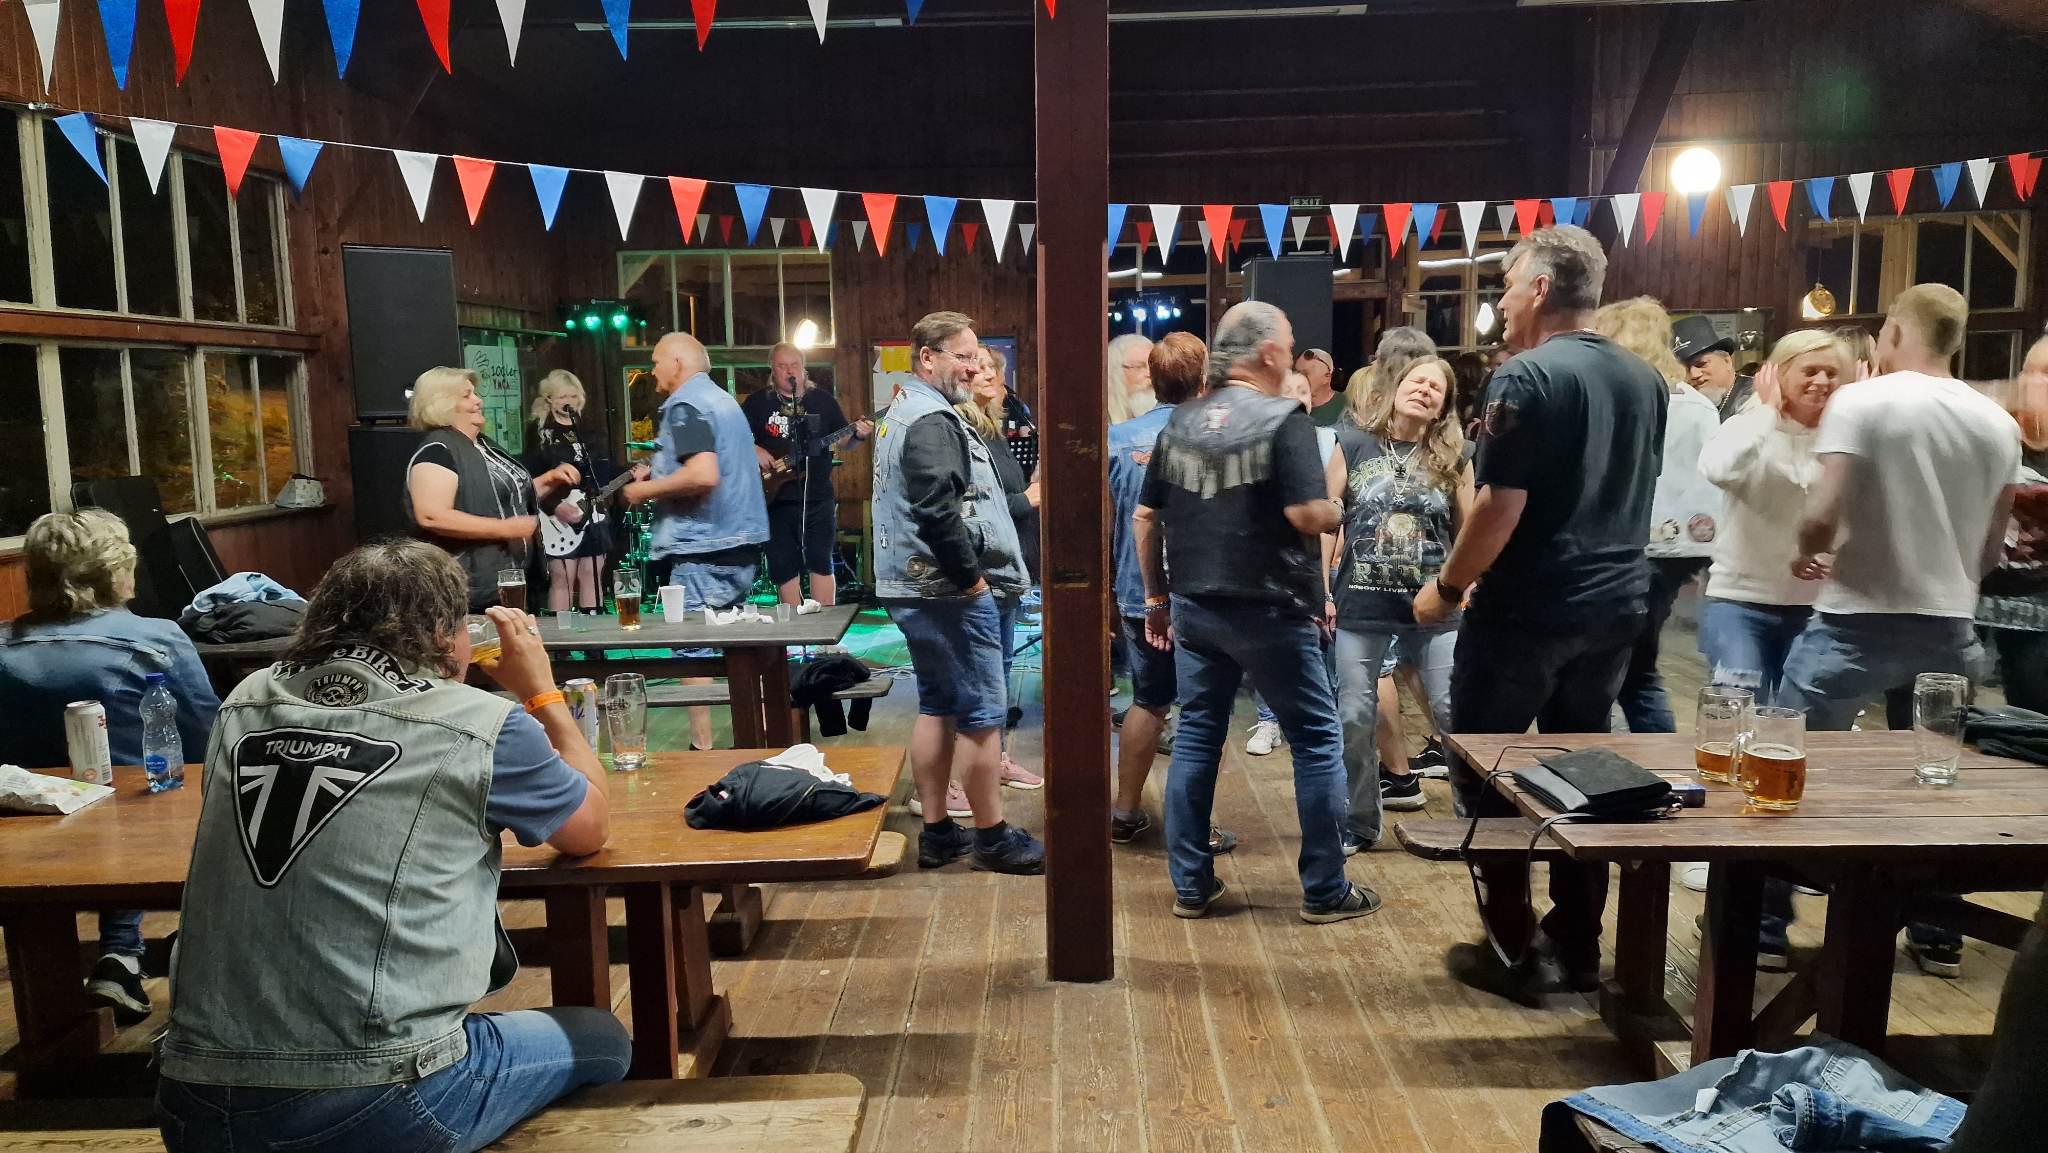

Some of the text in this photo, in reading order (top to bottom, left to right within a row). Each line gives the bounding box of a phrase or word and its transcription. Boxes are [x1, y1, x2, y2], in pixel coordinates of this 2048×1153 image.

[1293, 198, 1321, 206] EXIT
[1348, 584, 1382, 592] NOBODY
[316, 673, 363, 691] TRIUMPH
[265, 739, 352, 760] TRIUMPH
